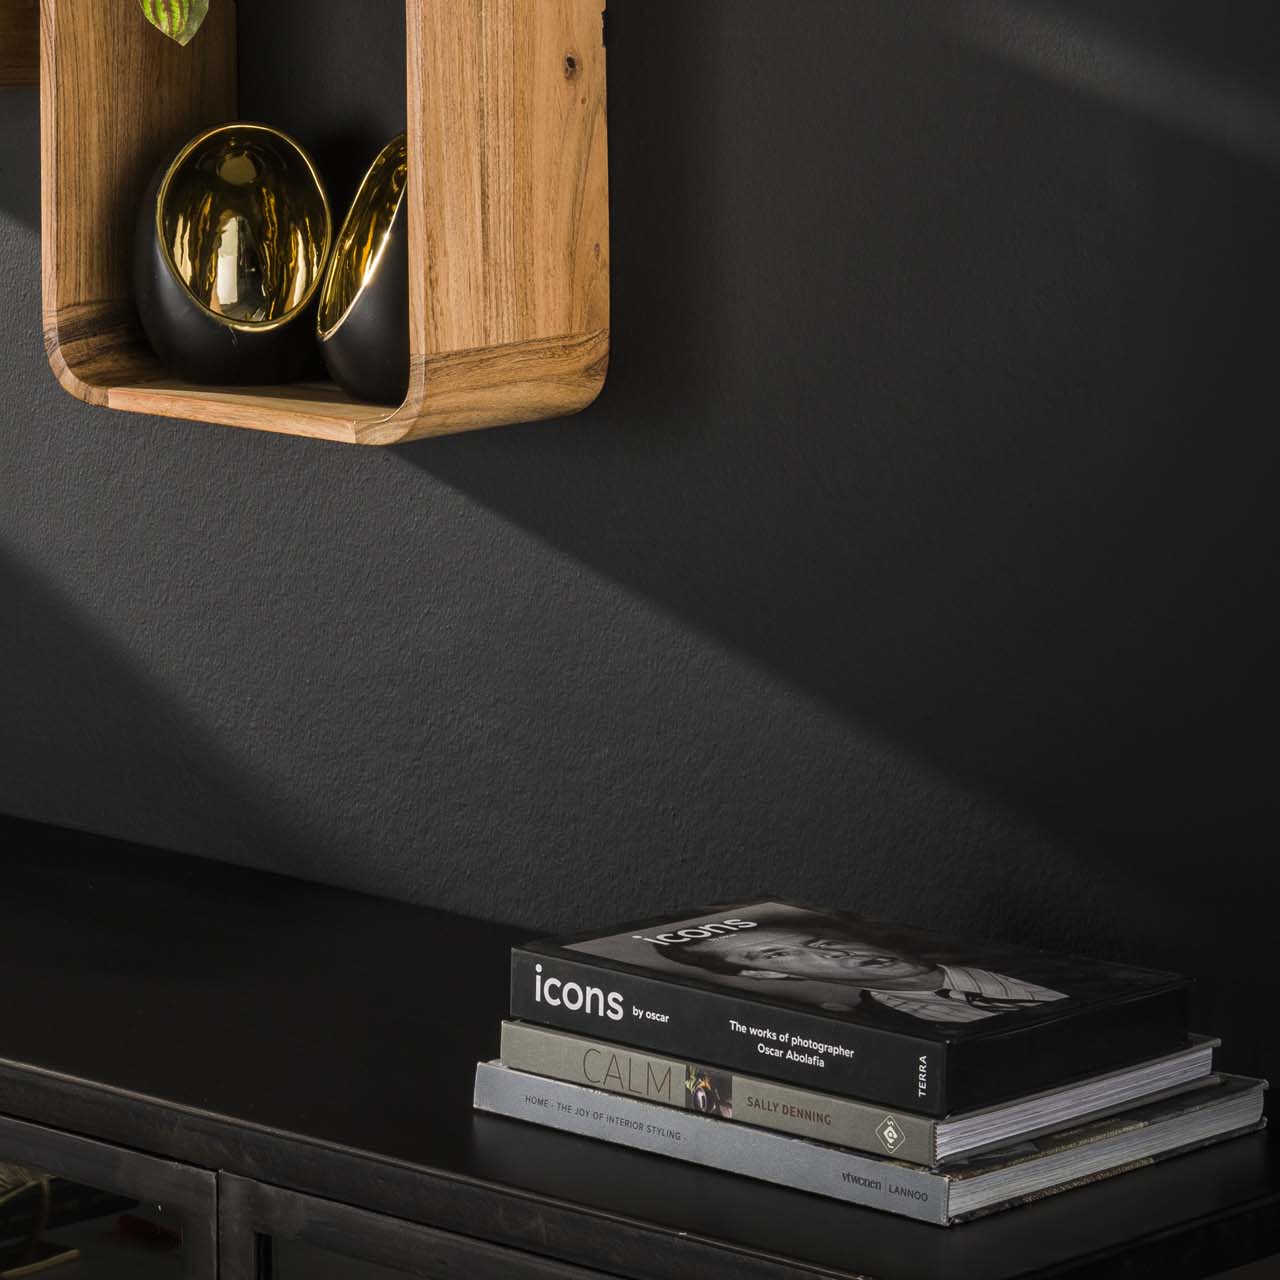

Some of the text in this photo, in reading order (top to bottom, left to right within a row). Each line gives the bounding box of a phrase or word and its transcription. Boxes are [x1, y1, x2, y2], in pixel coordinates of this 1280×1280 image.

[631, 918, 758, 946] icons
[535, 963, 670, 1023] icons by oscar
[729, 1019, 855, 1059] The works of photographer
[757, 1042, 825, 1068] Oscar Abolafia
[583, 1047, 672, 1101] CALM
[918, 1055, 927, 1098] TERRA
[525, 1095, 549, 1108] HOME
[557, 1102, 572, 1114] THE
[575, 1107, 590, 1118] JOY
[592, 1111, 604, 1122] OF
[606, 1114, 643, 1132] INTERIOR
[646, 1124, 682, 1142] STYLING
[747, 1096, 833, 1127] SALLY DENNING
[888, 1184, 929, 1202] LANNOO
